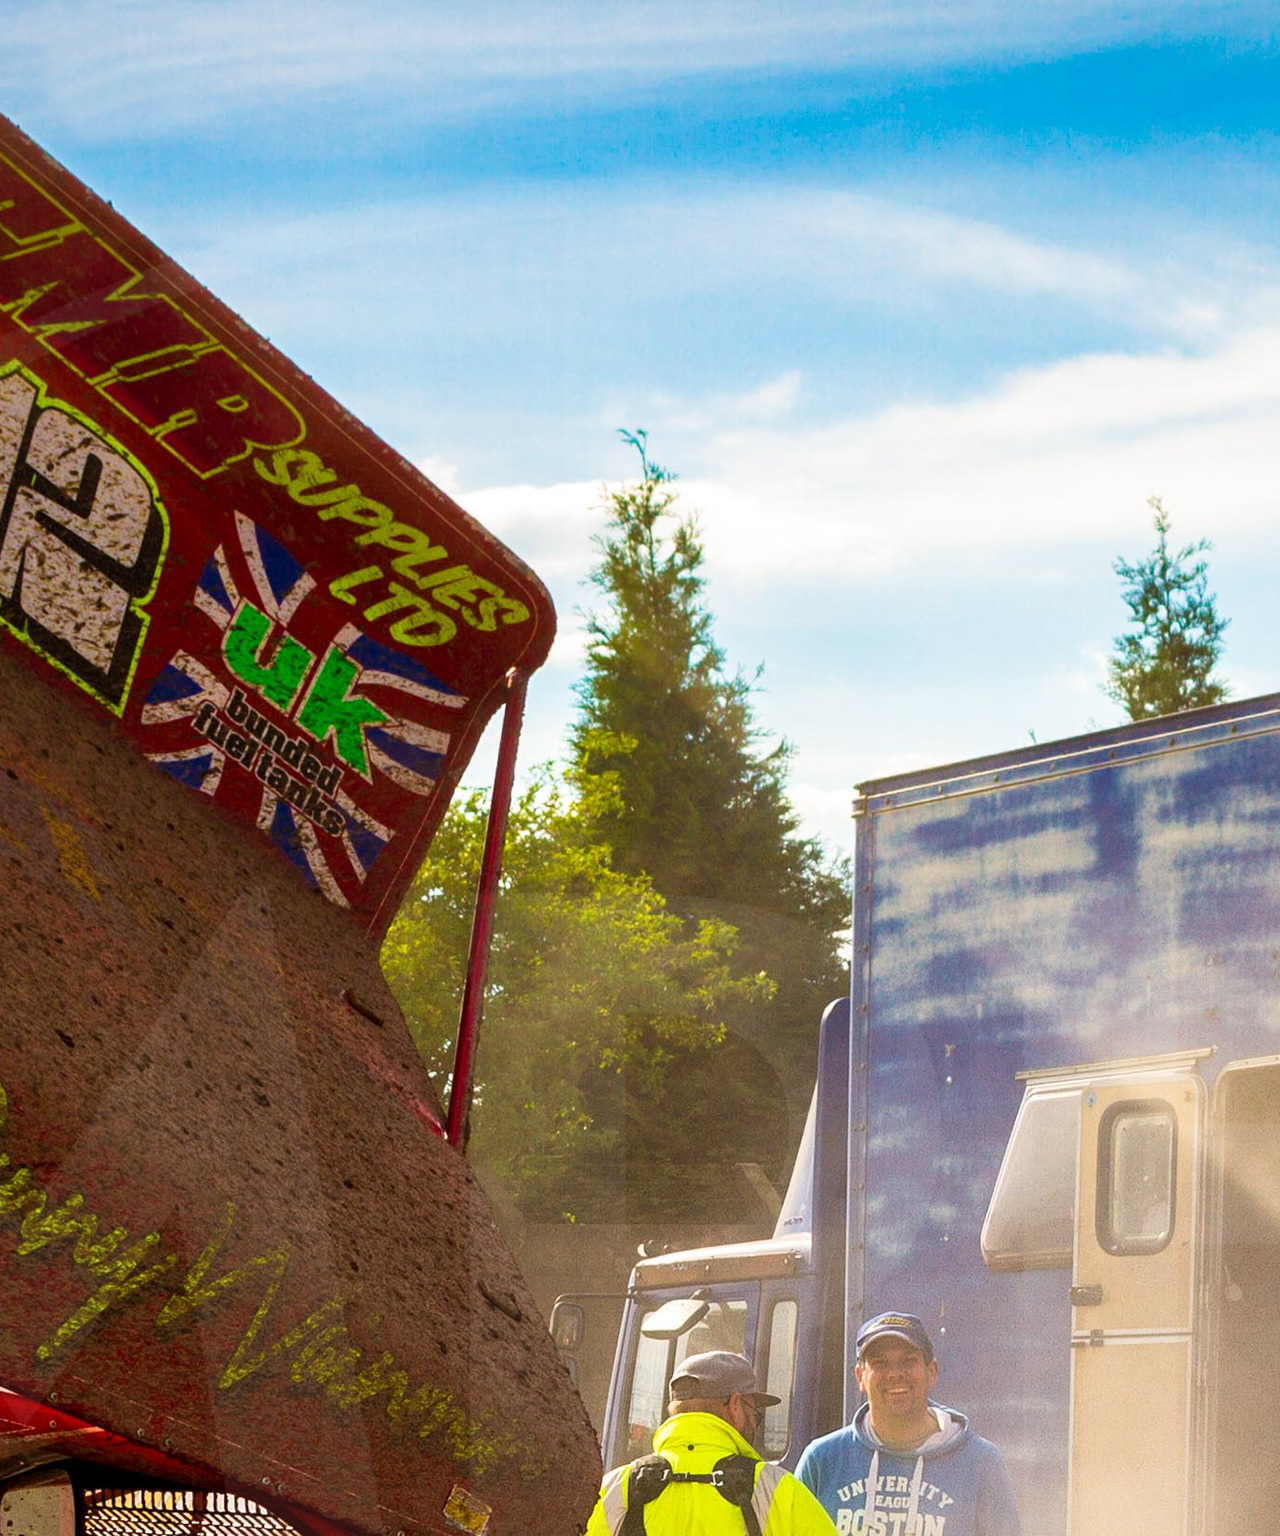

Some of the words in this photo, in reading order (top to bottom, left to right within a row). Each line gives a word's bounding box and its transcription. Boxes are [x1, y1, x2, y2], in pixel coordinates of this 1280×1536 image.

[251, 446, 531, 635] SUPPLIES
[328, 563, 457, 650] LTD
[220, 597, 402, 788] uk
[224, 686, 344, 800] bunded
[191, 700, 261, 772] fuel
[255, 750, 346, 837] tanks
[873, 1494, 911, 1509] EAGU
